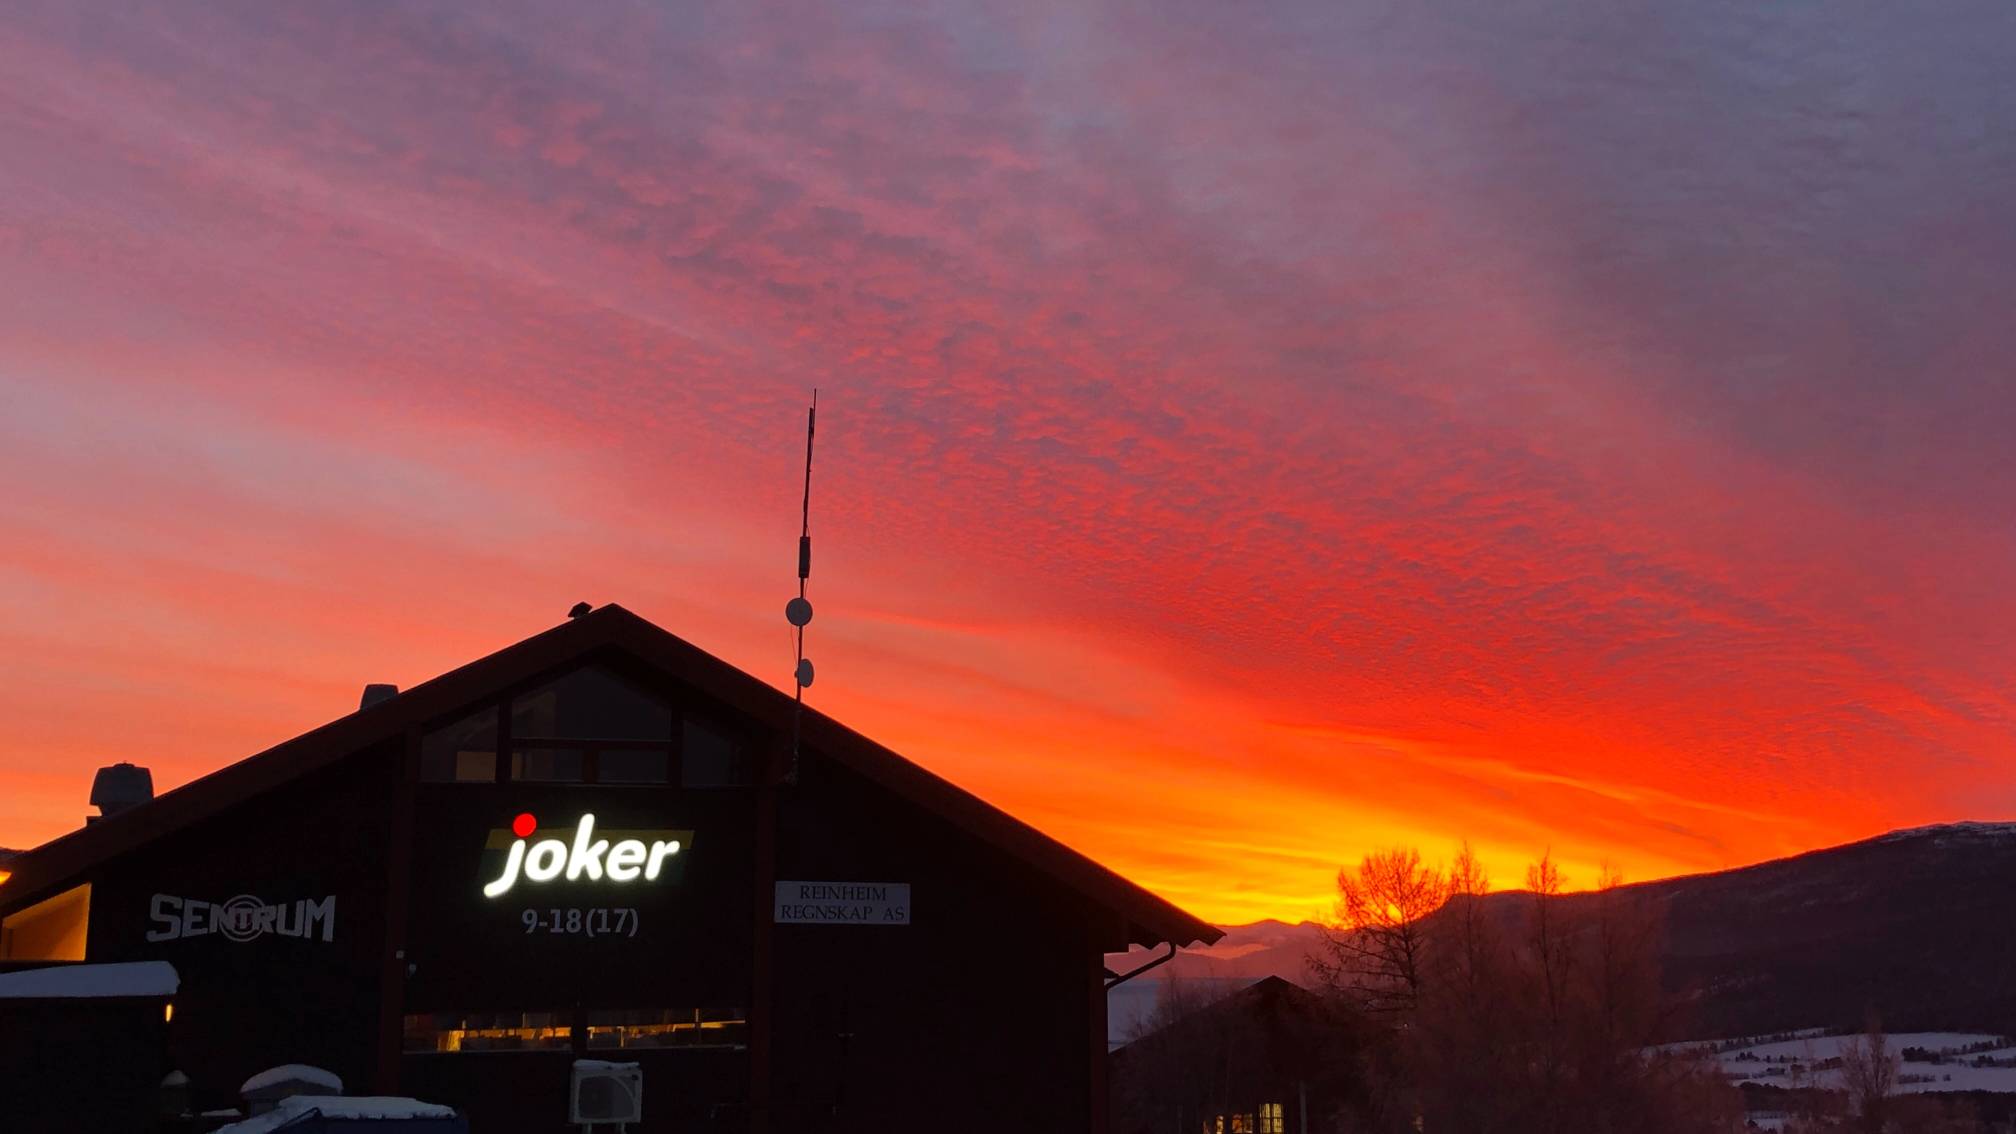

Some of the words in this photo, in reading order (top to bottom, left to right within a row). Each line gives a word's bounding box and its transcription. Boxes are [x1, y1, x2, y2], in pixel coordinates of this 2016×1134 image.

[483, 811, 681, 899] joker
[799, 885, 887, 901] REINHEIM
[146, 893, 336, 943] SENTRUM
[521, 907, 640, 938] 9-18(17)
[781, 905, 873, 921] REGNSKAP
[882, 905, 905, 921] AS
